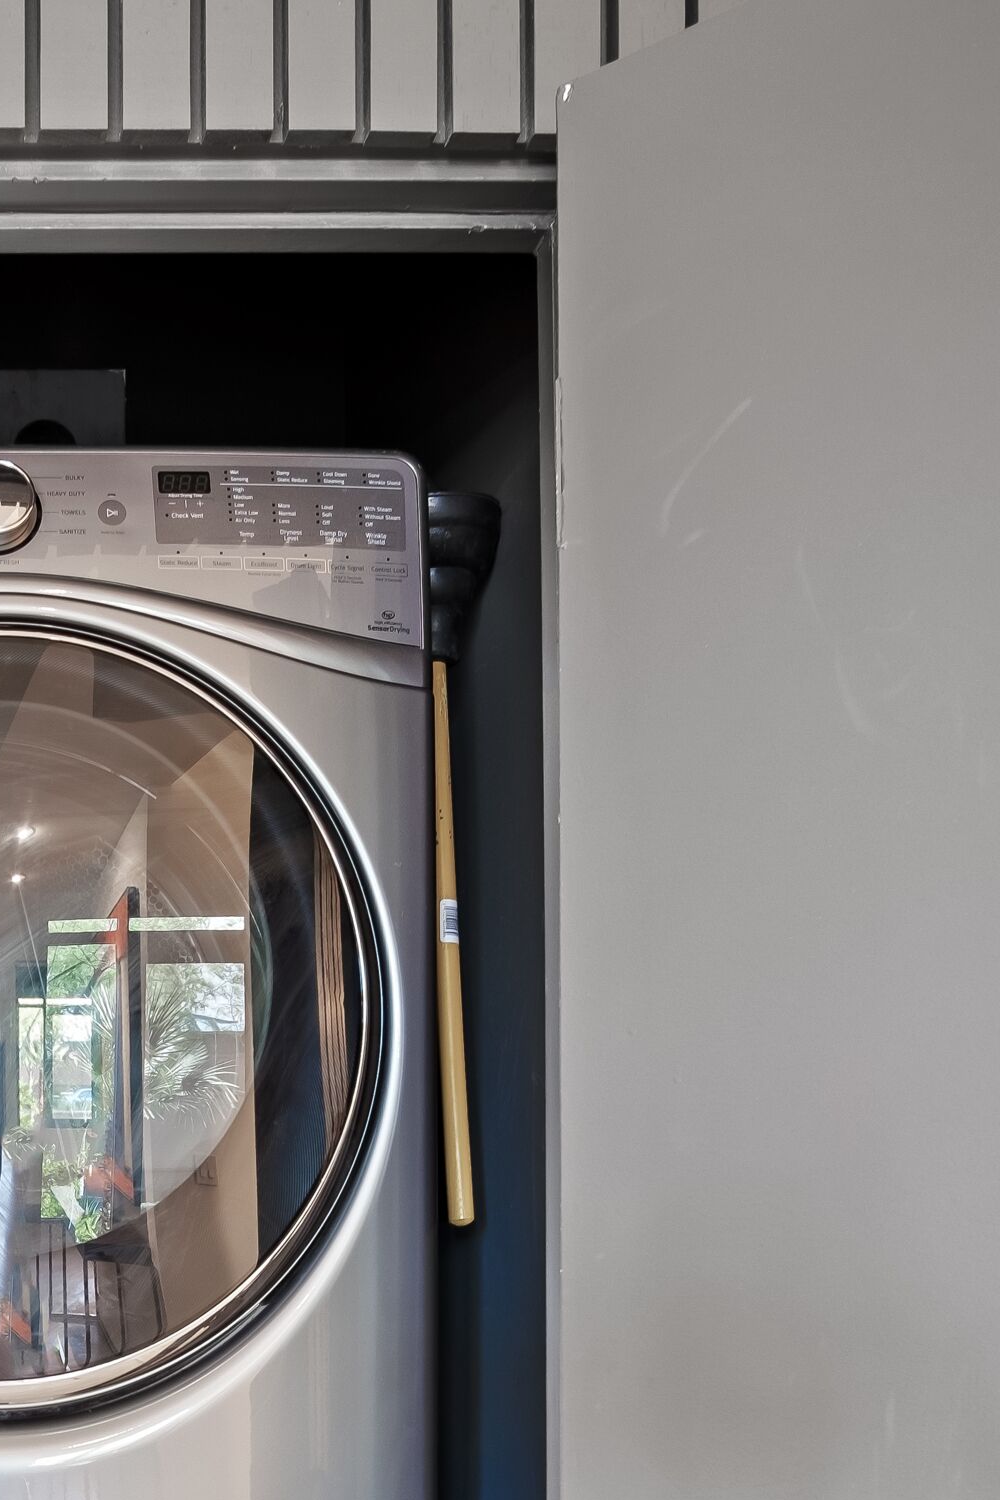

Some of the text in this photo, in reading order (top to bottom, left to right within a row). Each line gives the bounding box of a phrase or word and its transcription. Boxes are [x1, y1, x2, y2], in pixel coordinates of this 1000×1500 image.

[367, 538, 386, 546] Shield
[177, 559, 198, 567] Reduce
[330, 563, 365, 573] Cycle Signal
[393, 566, 406, 574] Lock
